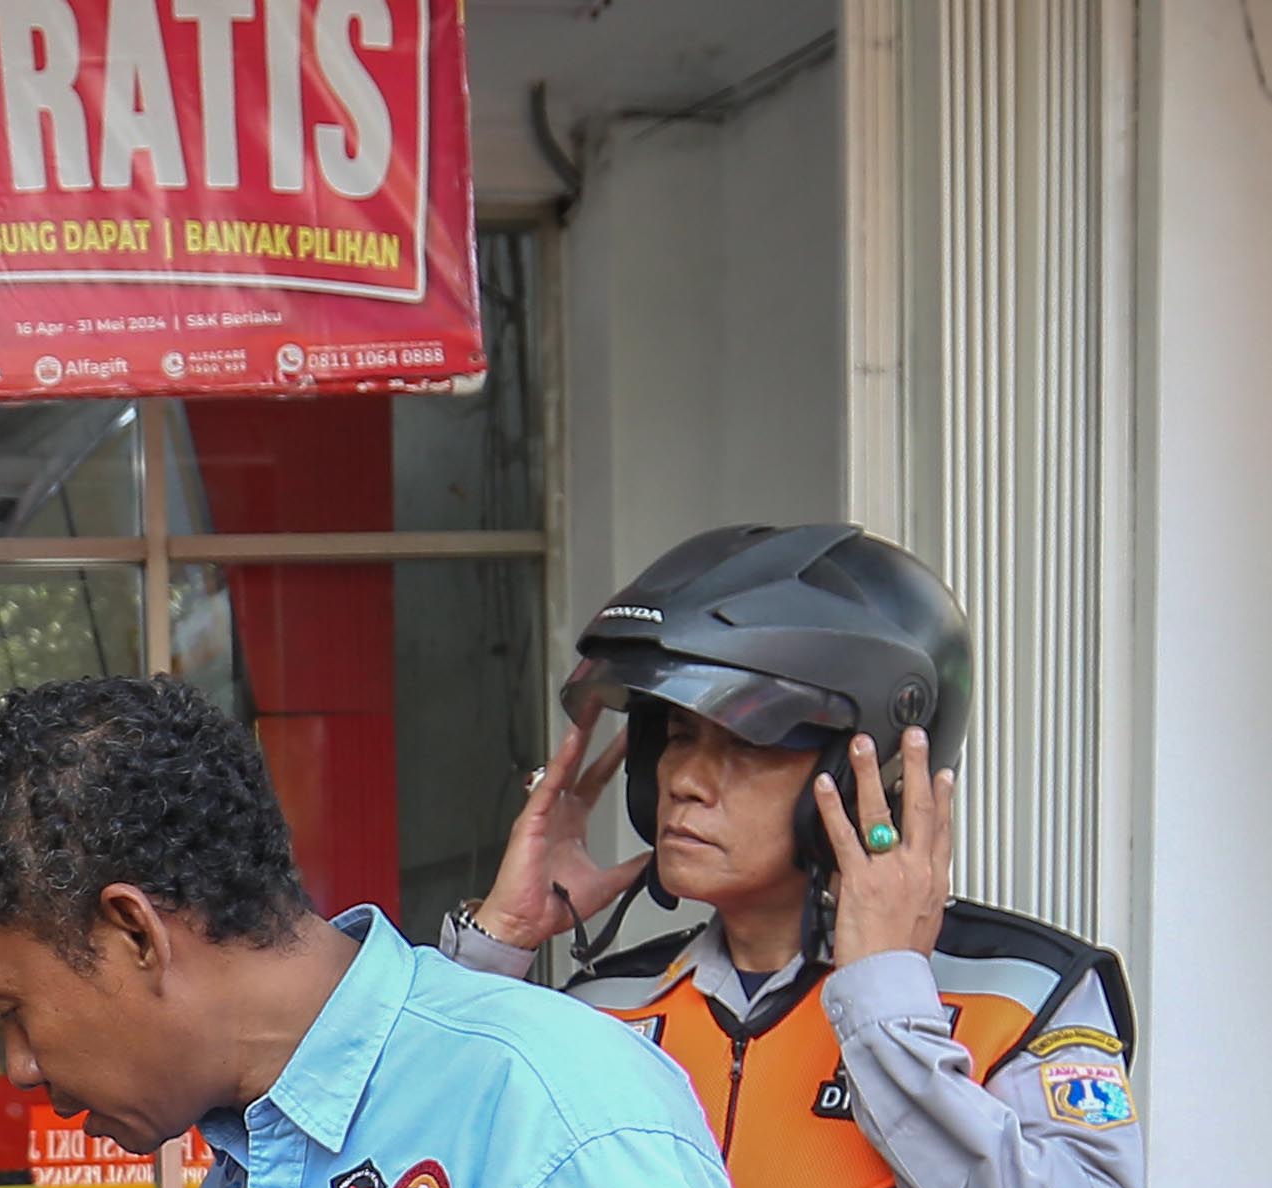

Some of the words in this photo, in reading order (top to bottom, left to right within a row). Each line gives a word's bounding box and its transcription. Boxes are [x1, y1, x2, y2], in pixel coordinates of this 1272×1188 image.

[63, 219, 150, 253] DAPAT
[185, 220, 293, 257] BANYAK
[297, 229, 400, 269] PILIHAN
[16, 321, 32, 335] 16
[35, 321, 64, 336] Apr
[77, 319, 93, 333] 31
[97, 317, 125, 331] Mei
[127, 316, 166, 331] 2024
[186, 314, 219, 328] S&K
[222, 310, 283, 325] Berlaku
[188, 349, 247, 361] ALFACARE
[308, 354, 350, 369] 0811
[355, 351, 398, 367] 1064
[402, 347, 445, 366] 0888
[65, 357, 128, 378] Alfagift
